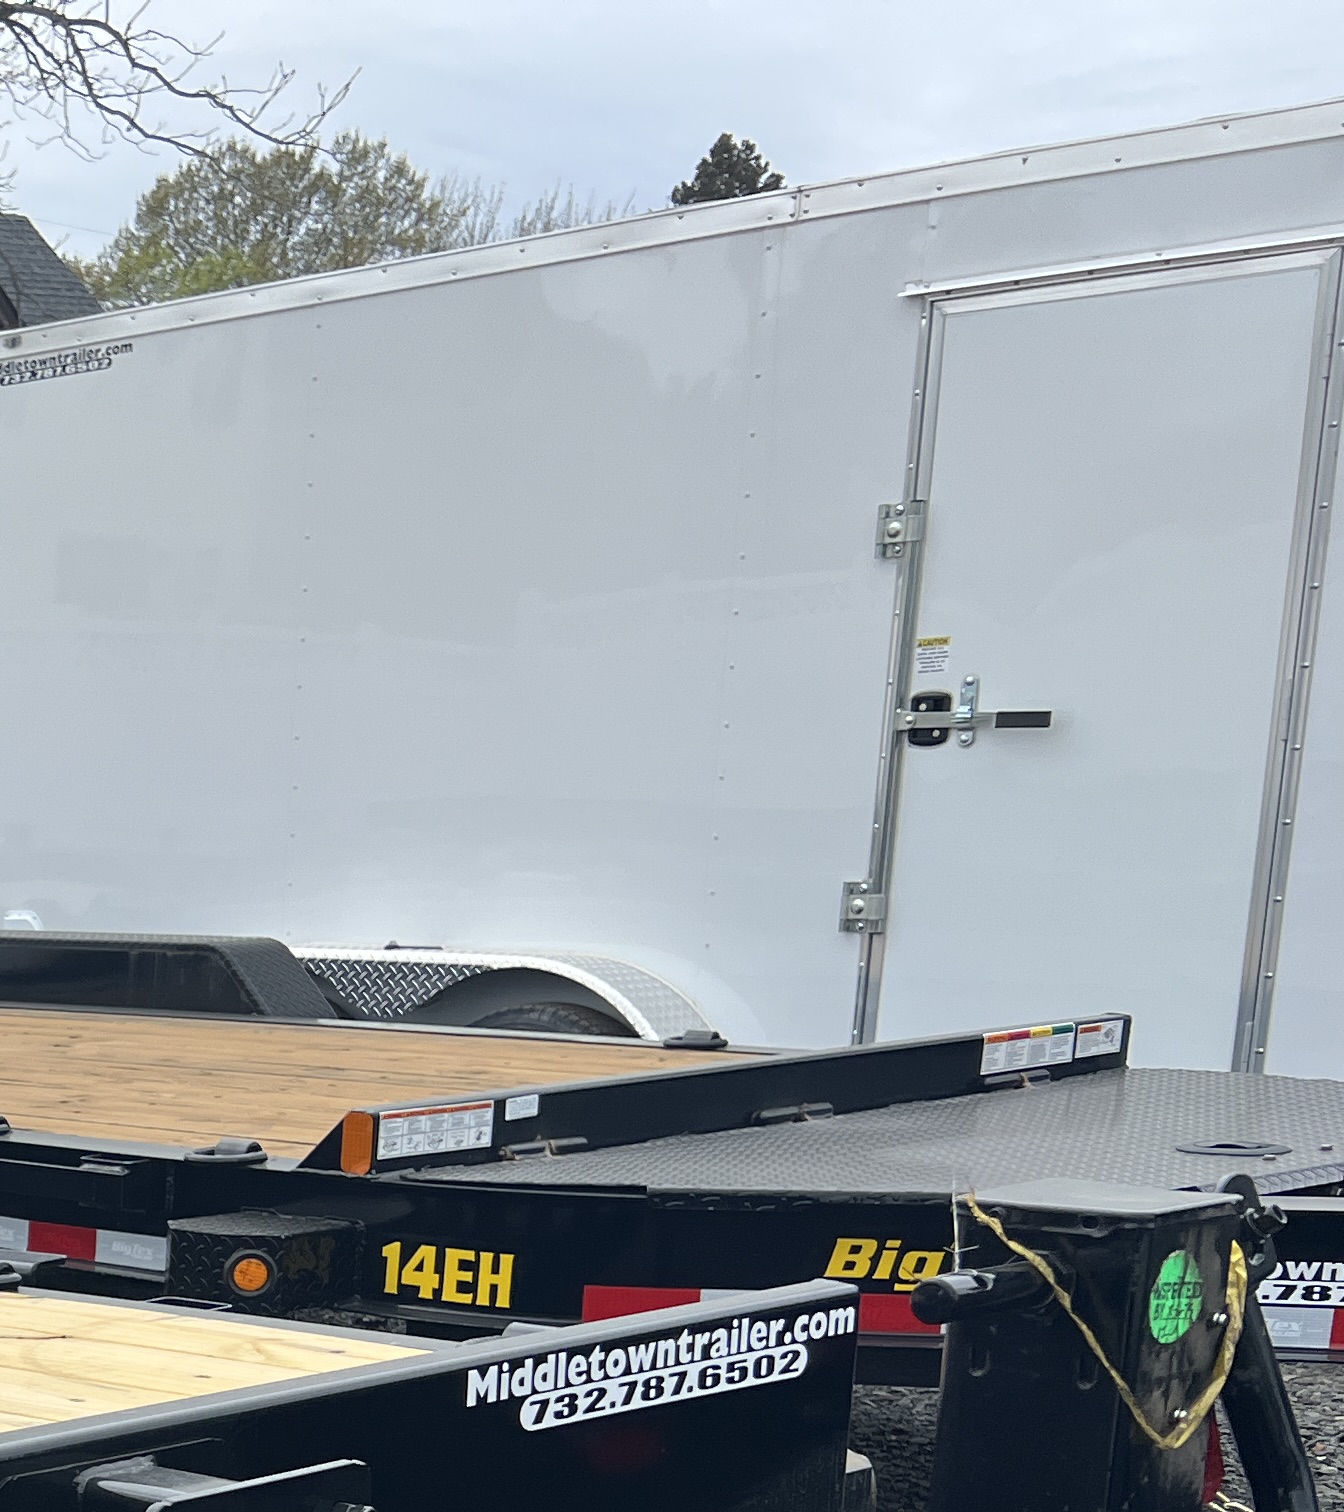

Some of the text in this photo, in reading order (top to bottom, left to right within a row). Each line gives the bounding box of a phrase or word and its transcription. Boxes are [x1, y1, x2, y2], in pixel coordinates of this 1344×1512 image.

[381, 1240, 514, 1308] 14EH
[465, 1305, 855, 1408] Middletowntrailer.com
[529, 1349, 801, 1426] 732.787.6502
